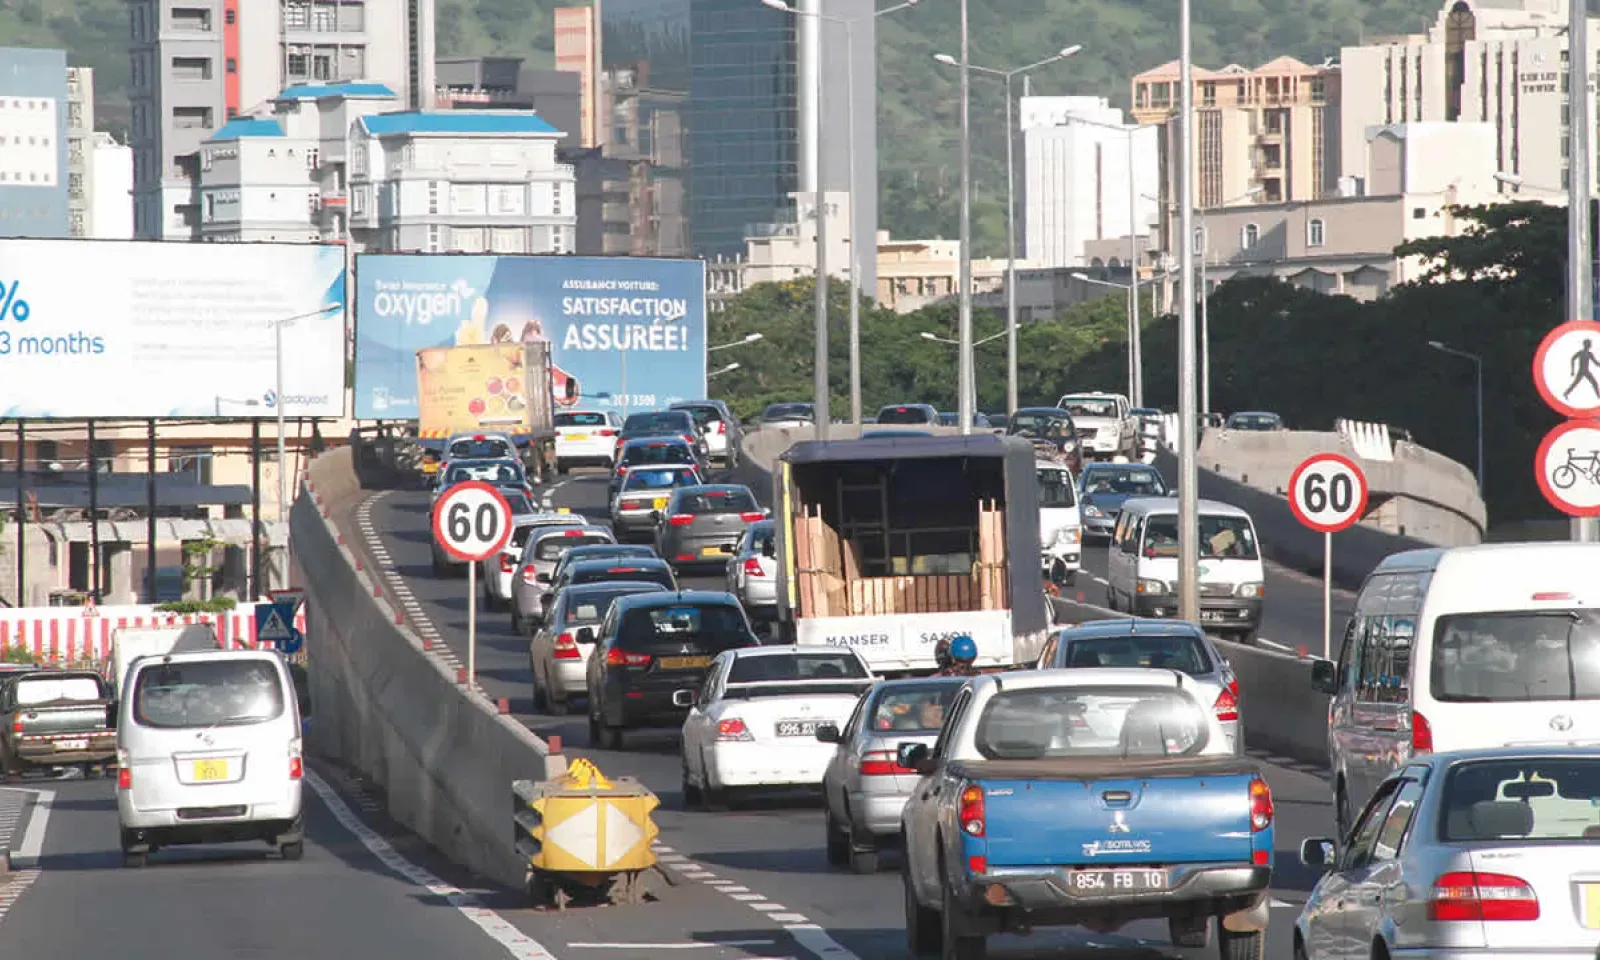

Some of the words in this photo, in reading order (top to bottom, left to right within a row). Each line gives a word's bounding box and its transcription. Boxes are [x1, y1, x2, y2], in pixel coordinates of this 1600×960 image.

[374, 292, 461, 324] oxygen
[562, 295, 688, 316] SATISFACTION
[18, 330, 105, 354] months
[563, 318, 688, 351] ASSURÉE!
[1303, 472, 1353, 513] 60
[448, 502, 498, 543] 60
[825, 634, 889, 647] MANSER
[1076, 874, 1106, 888] 854
[1112, 873, 1133, 887] FB
[1143, 873, 1162, 887] 10
